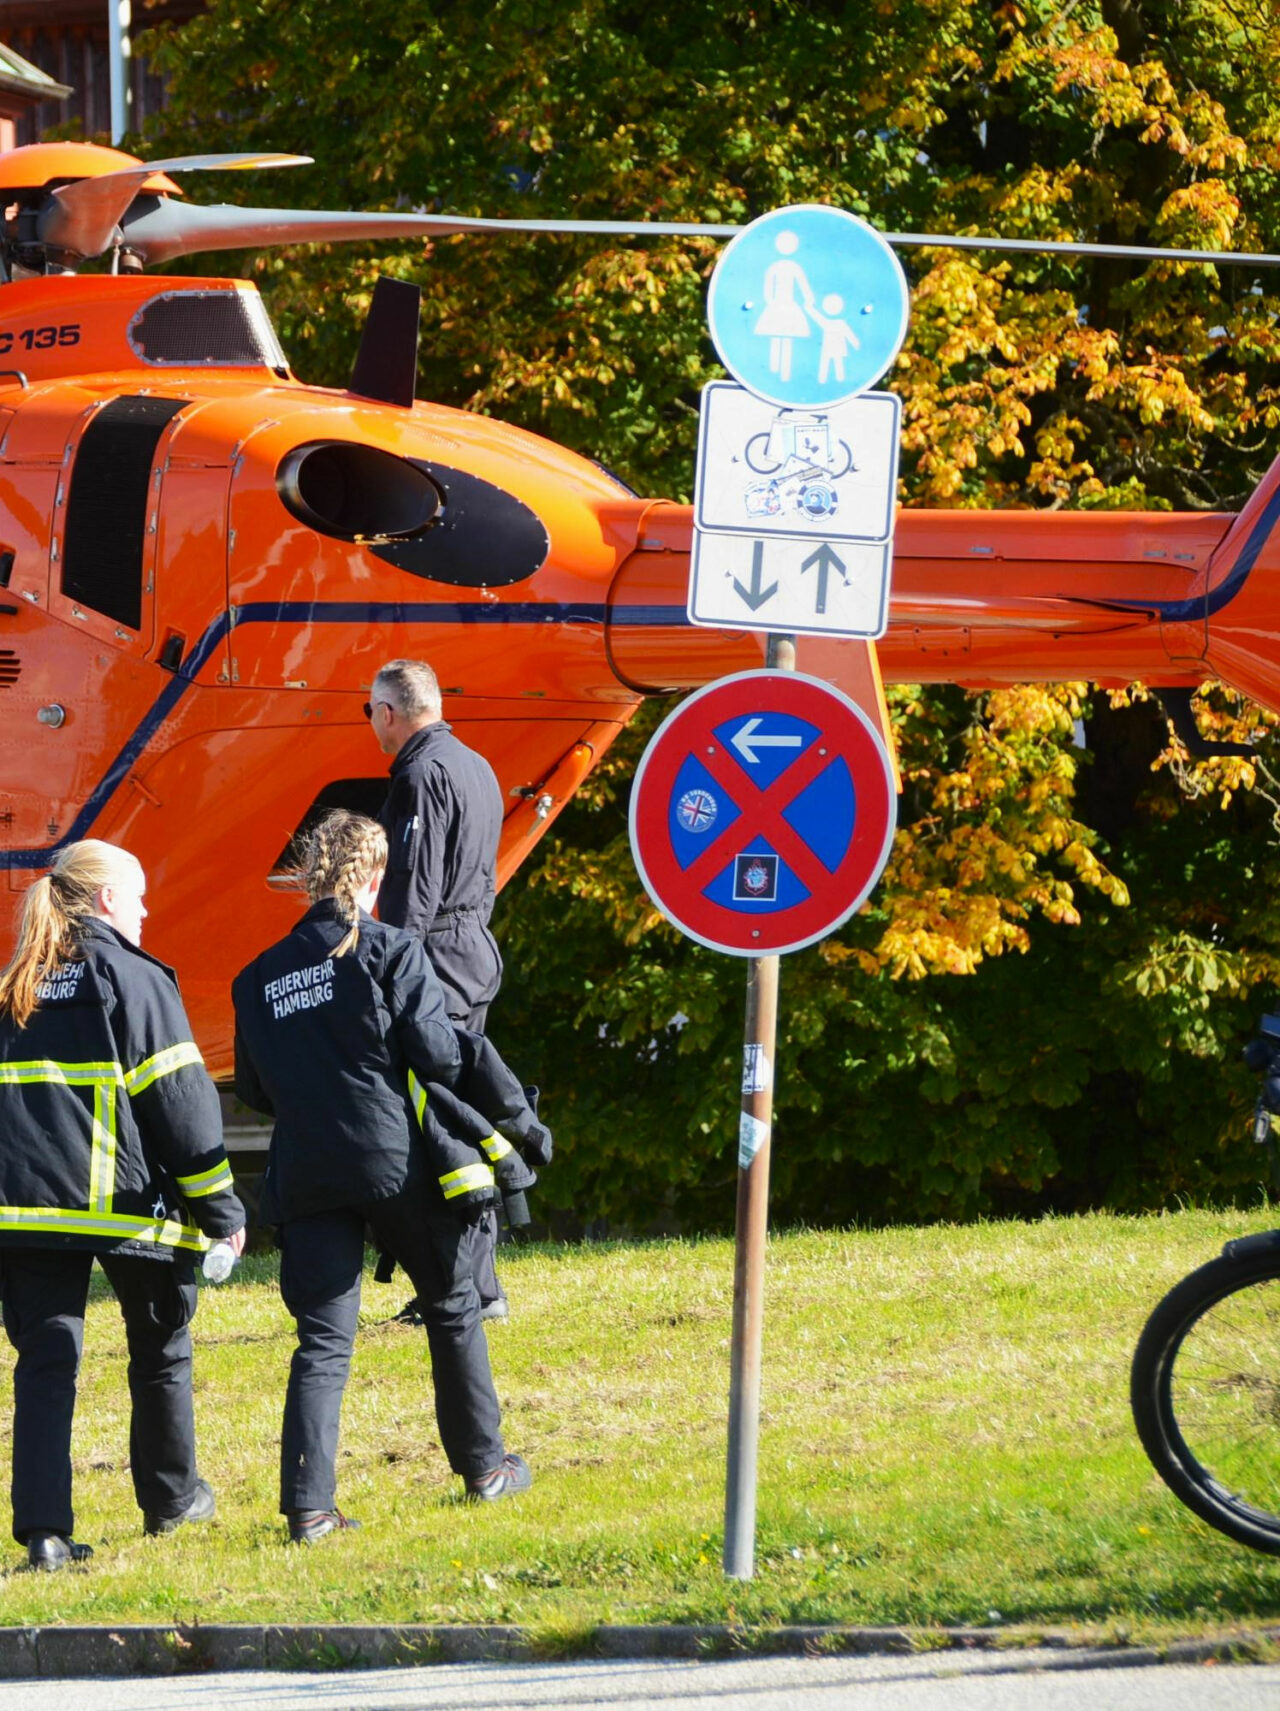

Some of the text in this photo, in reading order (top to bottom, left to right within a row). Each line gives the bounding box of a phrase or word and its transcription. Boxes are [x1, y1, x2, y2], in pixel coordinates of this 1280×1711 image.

[19, 324, 81, 350] 135
[264, 958, 336, 1003] FEUERWEHR
[273, 982, 334, 1019] HAMBURG
